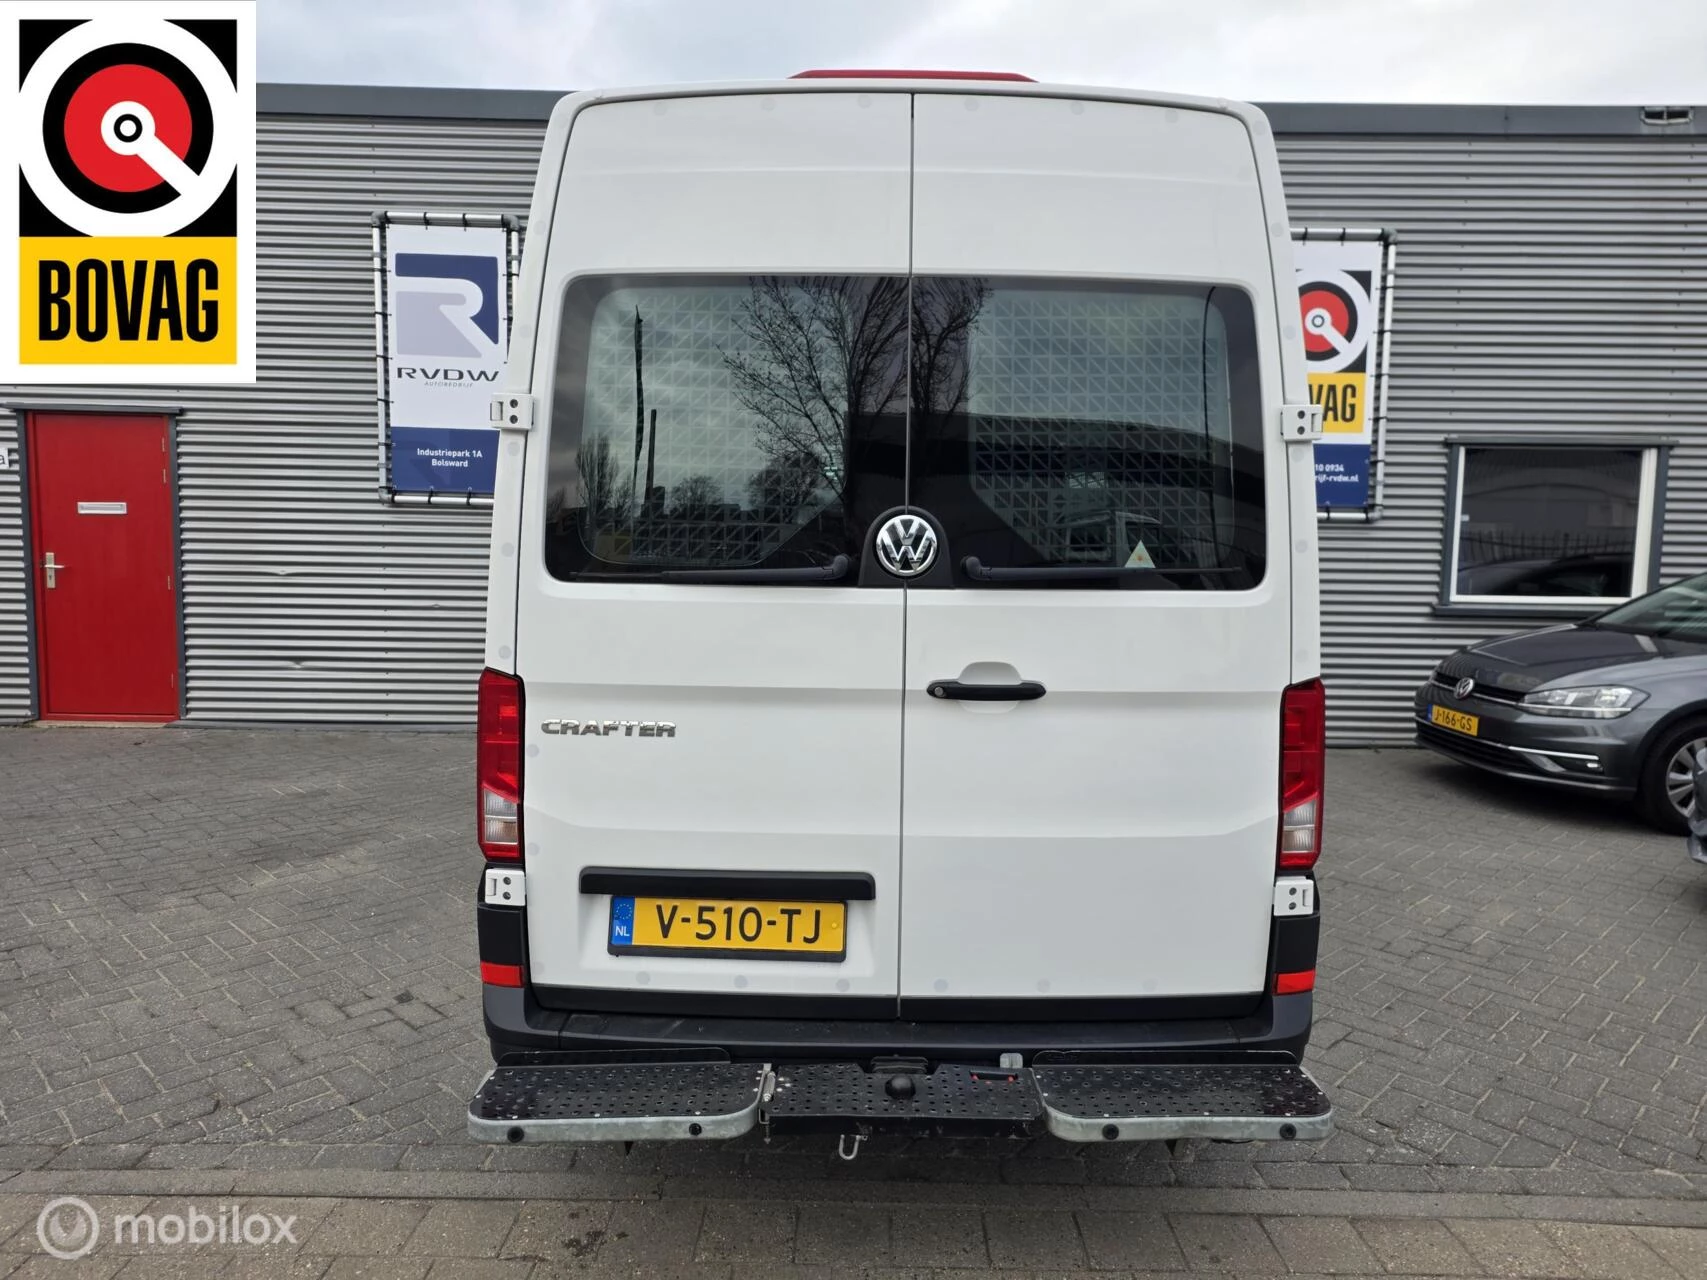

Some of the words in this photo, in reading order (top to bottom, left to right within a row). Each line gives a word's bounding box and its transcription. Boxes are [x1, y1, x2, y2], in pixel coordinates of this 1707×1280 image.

[397, 367, 500, 382] RVDW
[417, 448, 470, 458] Industriepark
[472, 450, 483, 458] 1A
[431, 459, 469, 468] Bolsward
[1434, 708, 1473, 732] J-166-GS
[541, 719, 677, 737] CRAFTER
[615, 926, 630, 937] NL
[656, 904, 821, 944] V-510-TJ
